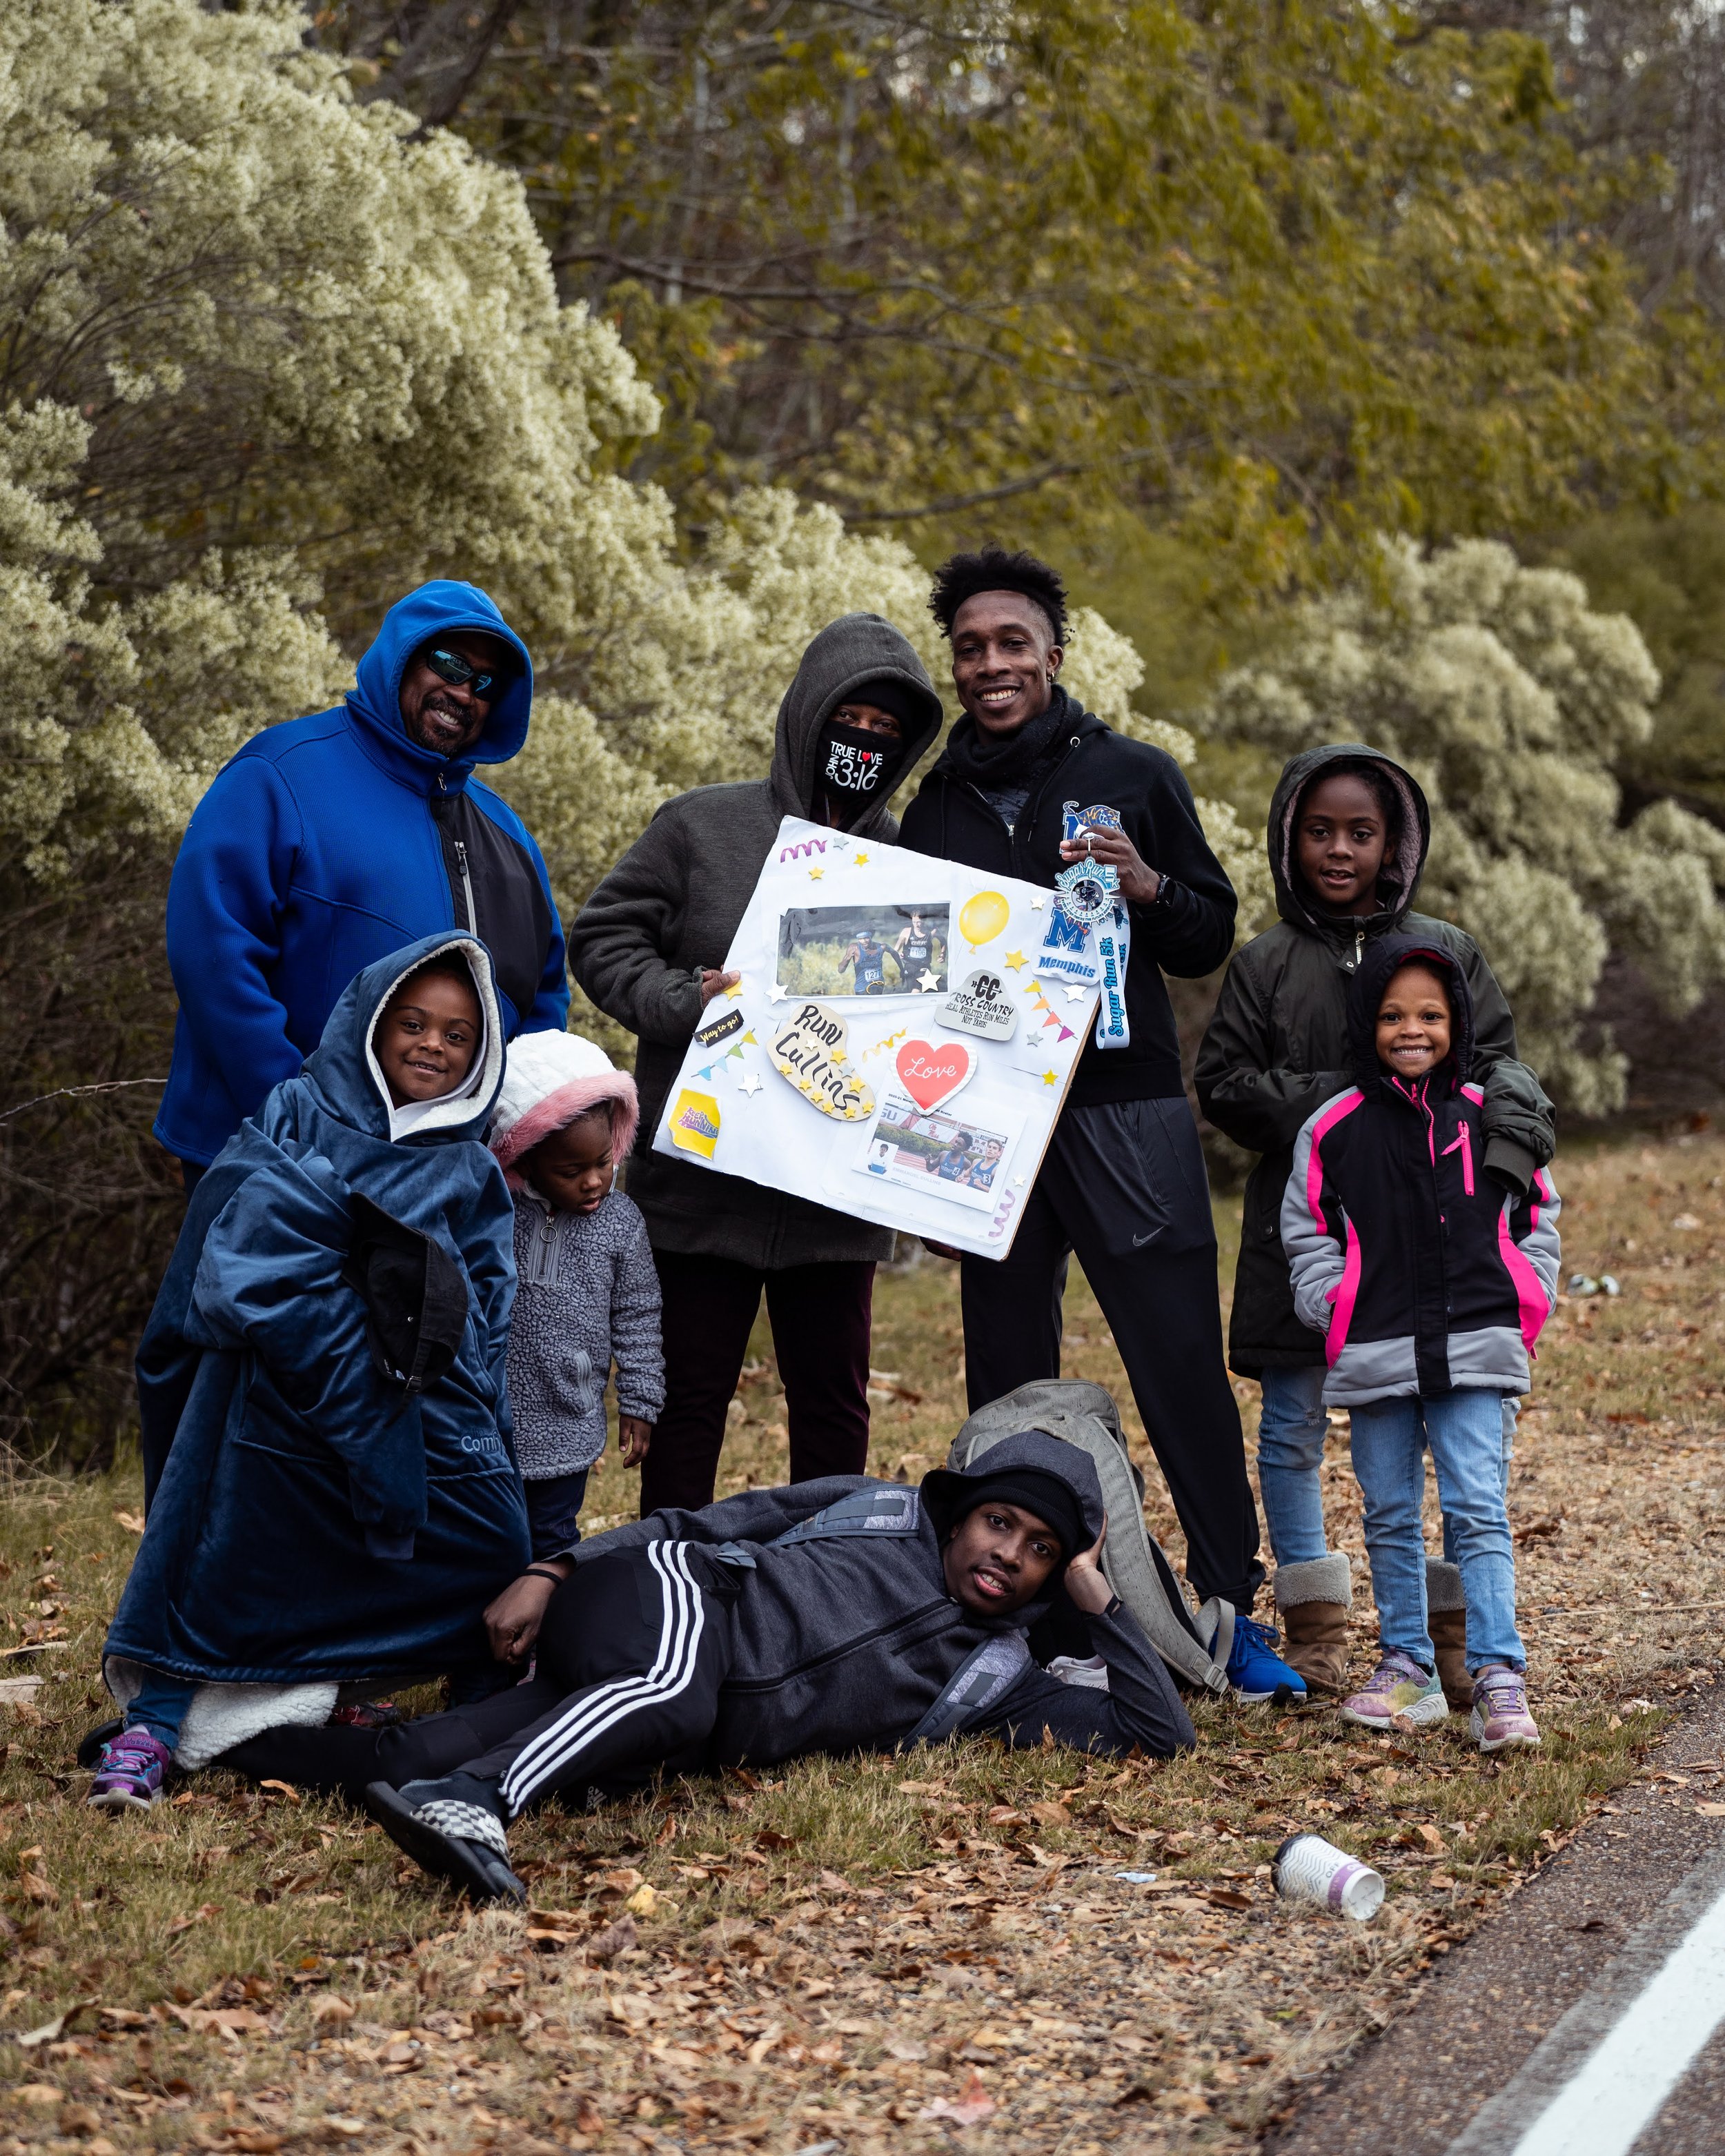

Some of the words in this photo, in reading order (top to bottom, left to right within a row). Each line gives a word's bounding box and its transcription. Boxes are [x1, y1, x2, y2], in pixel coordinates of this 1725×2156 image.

[831, 740, 857, 760] TRUE
[825, 753, 840, 780] JOHN
[834, 759, 879, 791] 3:16
[1055, 862, 1085, 890] Sugar
[1084, 856, 1105, 878] Run
[1043, 907, 1086, 953] M
[1038, 955, 1096, 978] Memphis
[1103, 958, 1118, 989] Run
[975, 975, 1000, 1001] CC
[949, 991, 976, 1007] CROSS
[977, 1000, 1014, 1018] COUNTRY
[958, 1005, 983, 1018] ATHLETES
[1108, 990, 1125, 1036] Sugar
[700, 1030, 718, 1042] Way
[727, 1015, 739, 1029] go!
[776, 1031, 860, 1110] Cullins
[904, 1057, 957, 1078] Love
[686, 1107, 704, 1120] KEEP
[984, 1175, 989, 1183] 3
[461, 1432, 500, 1452] Comf
